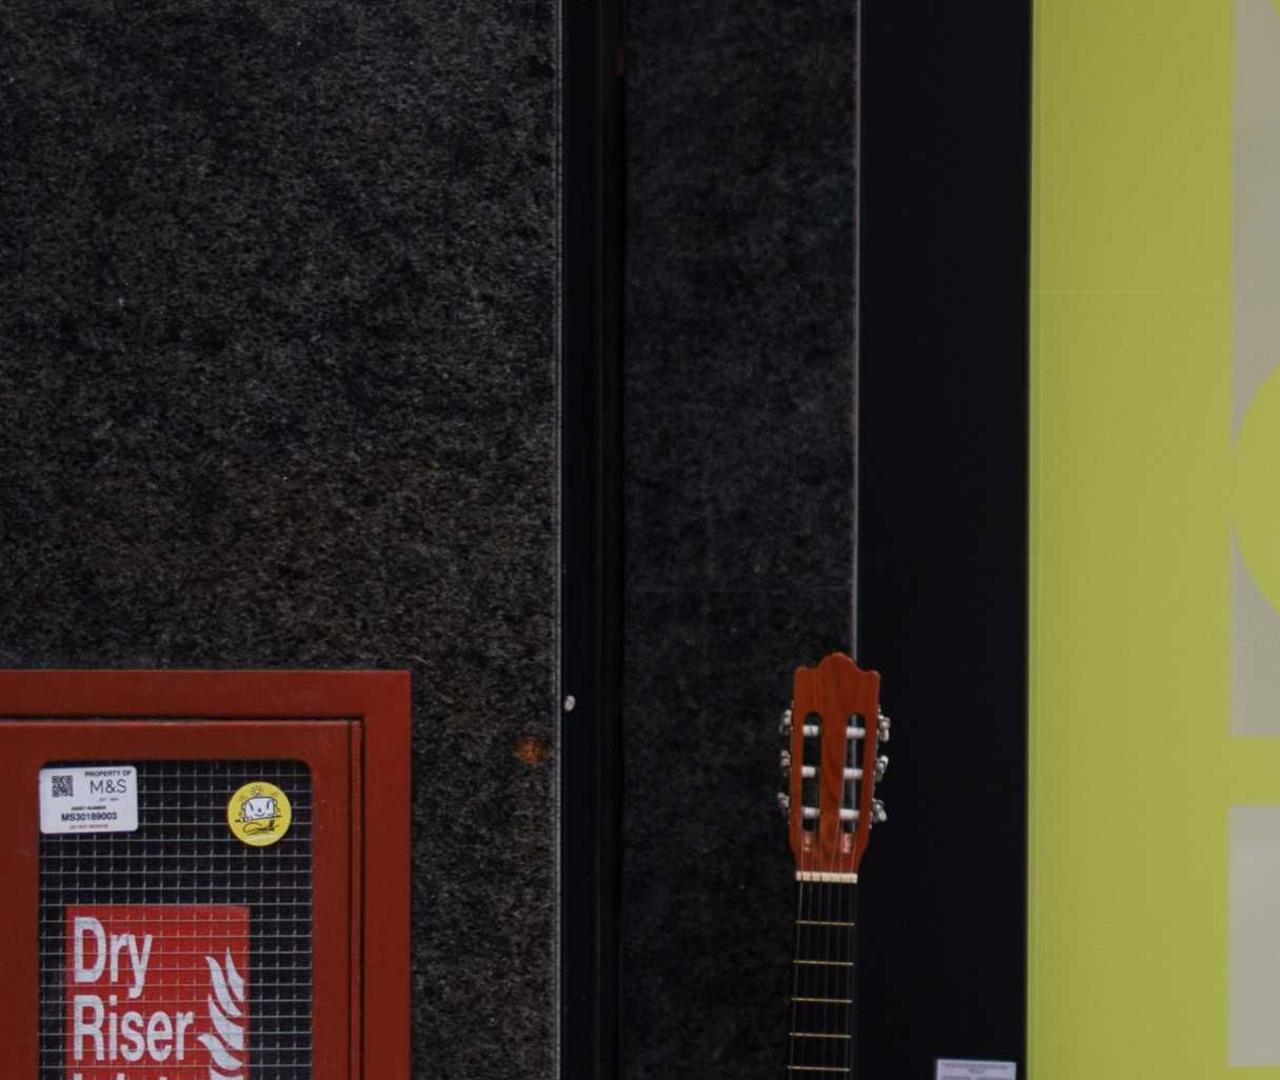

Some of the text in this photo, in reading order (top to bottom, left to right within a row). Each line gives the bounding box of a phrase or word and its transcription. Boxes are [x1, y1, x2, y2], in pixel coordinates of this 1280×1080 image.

[89, 778, 127, 794] M&S
[73, 916, 153, 999] Dry
[73, 994, 194, 1062] Riser
